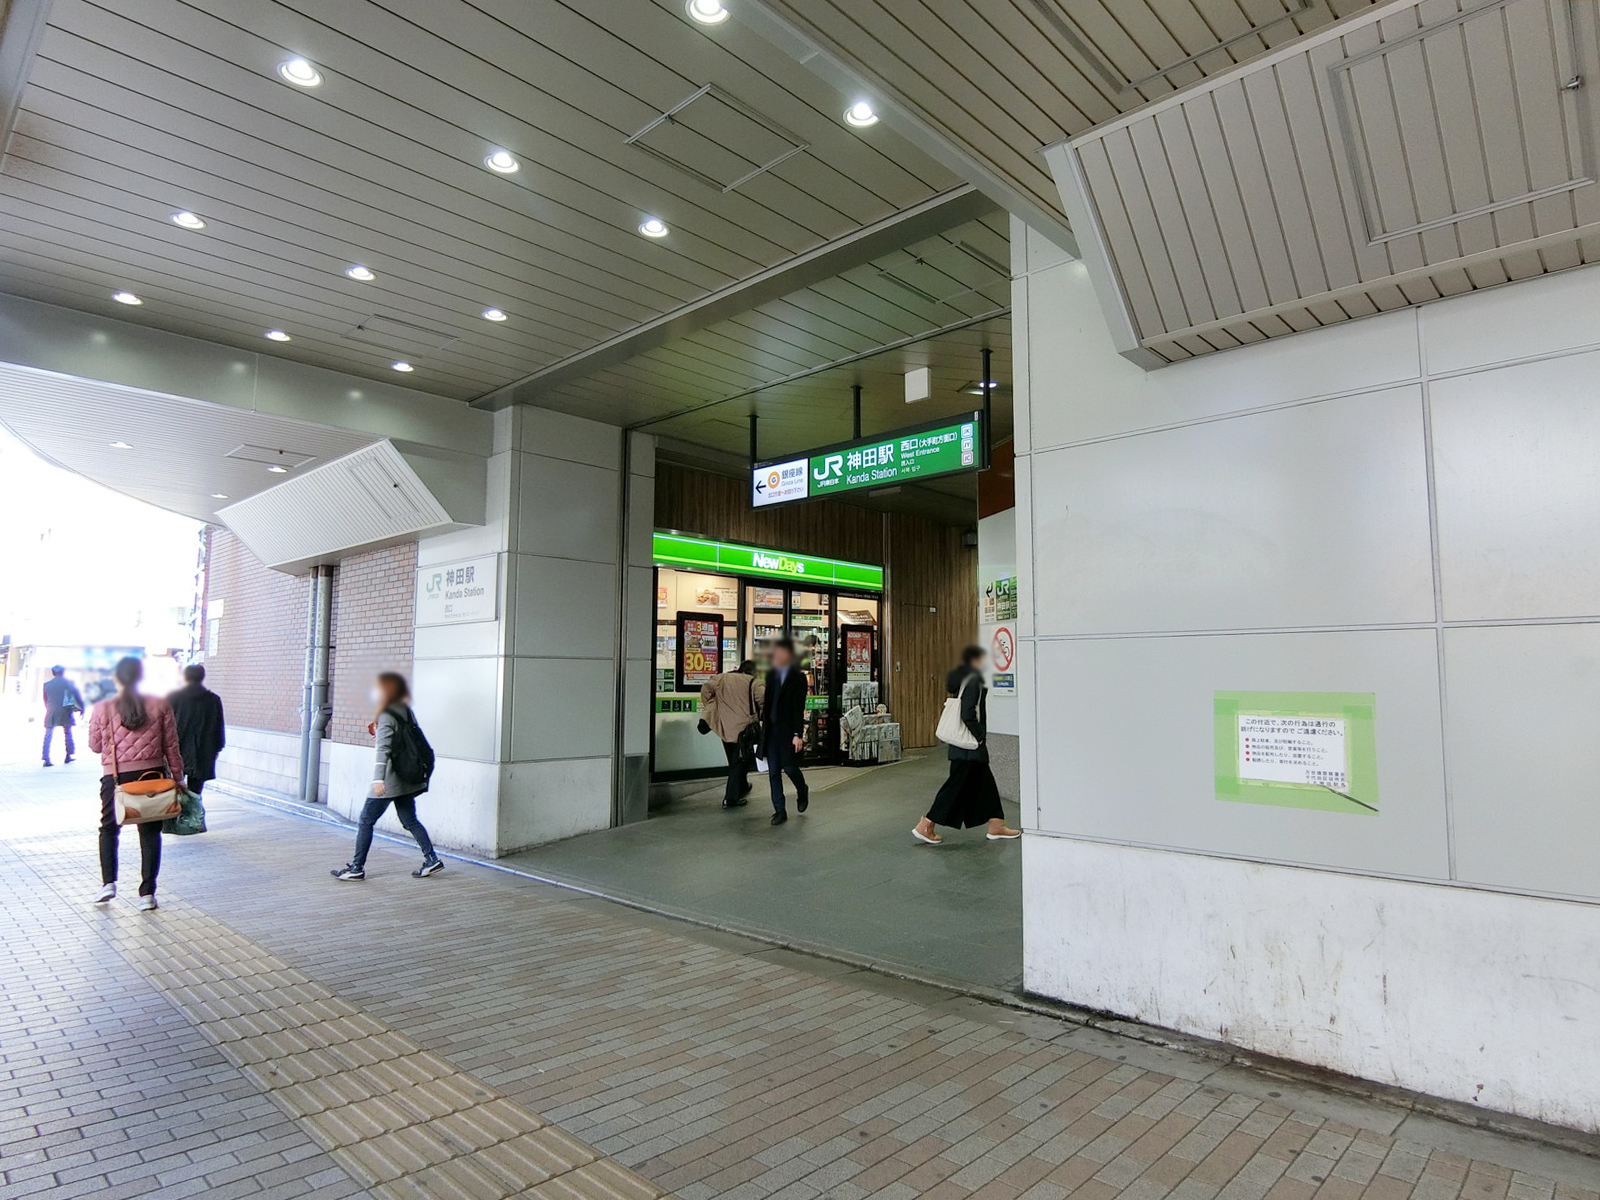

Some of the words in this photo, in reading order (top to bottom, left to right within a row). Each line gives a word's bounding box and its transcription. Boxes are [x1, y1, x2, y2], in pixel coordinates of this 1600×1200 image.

[846, 443, 895, 472] 神田駅
[900, 451, 915, 460] West
[915, 446, 940, 457] Entrance
[781, 466, 804, 480] 銀座線
[813, 454, 844, 481] JR
[846, 472, 870, 485] Kanda
[871, 467, 898, 481] Station
[752, 552, 806, 574] NewDays
[426, 573, 442, 593] JR
[446, 566, 475, 587] 神田駅
[445, 589, 463, 600] Kanda
[464, 585, 485, 598] Station
[996, 580, 1010, 597] JR
